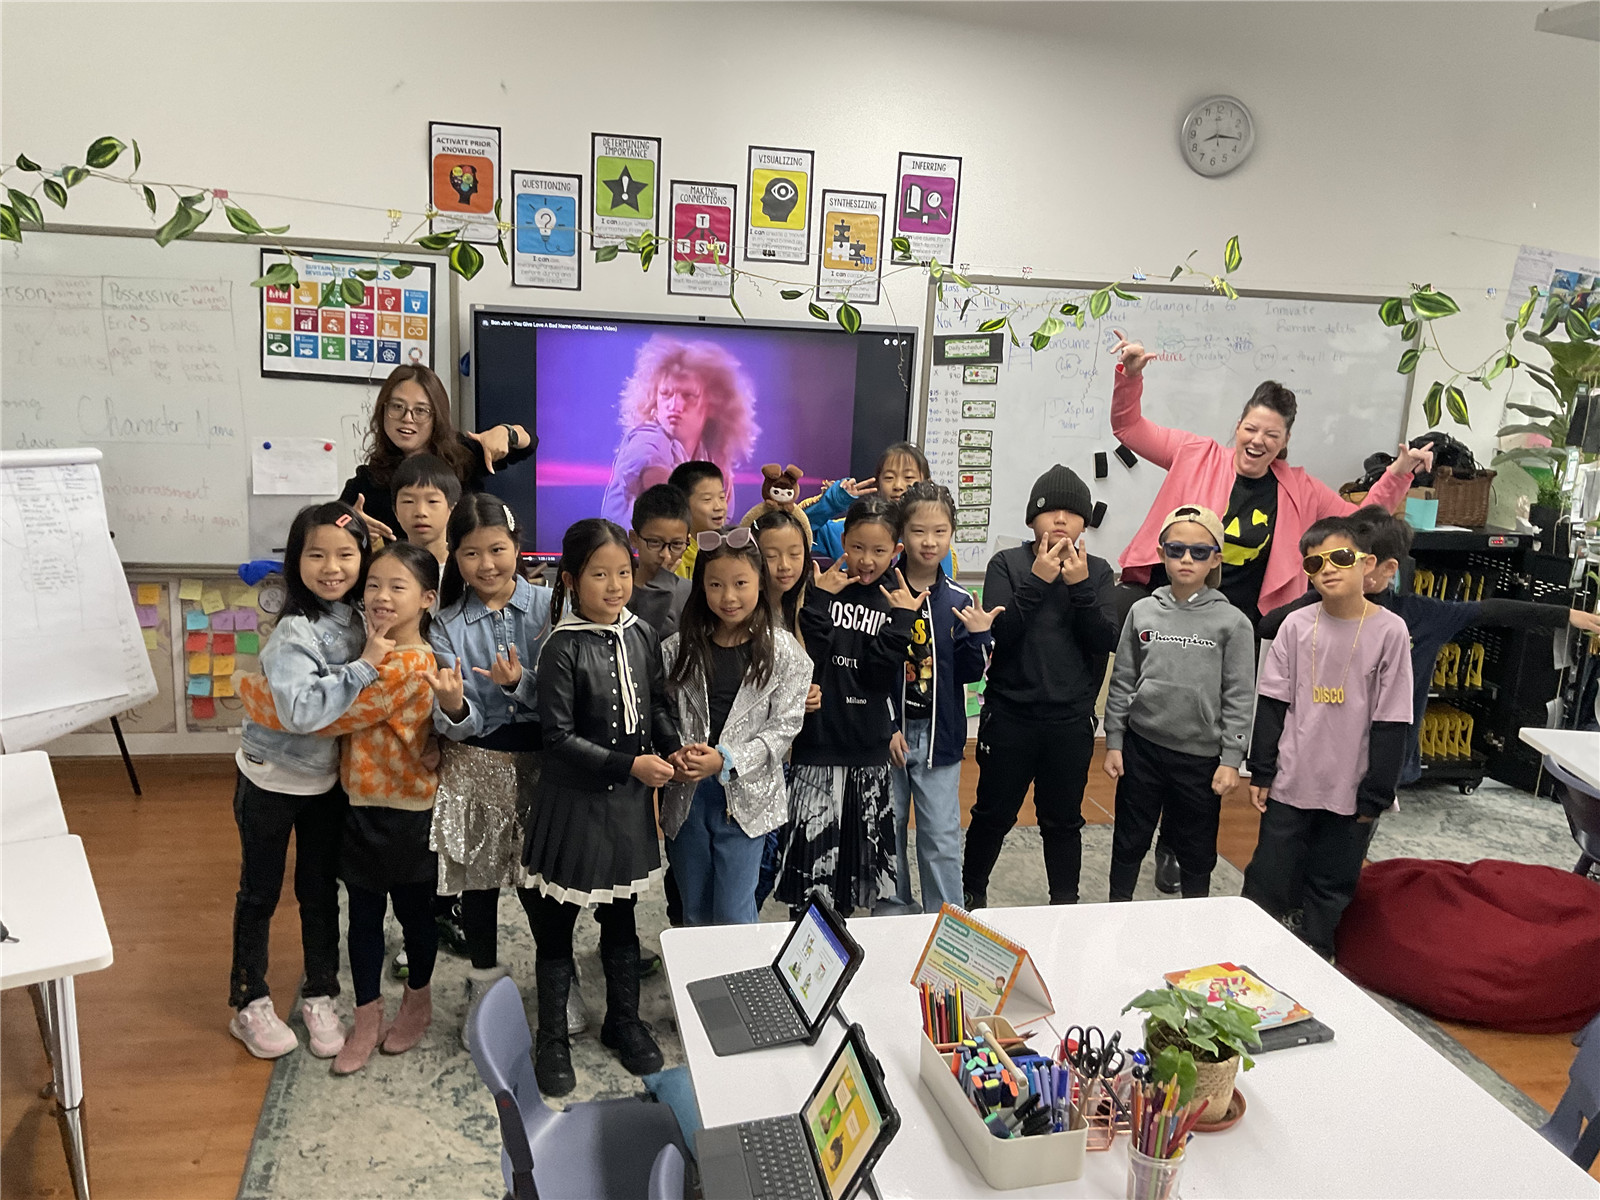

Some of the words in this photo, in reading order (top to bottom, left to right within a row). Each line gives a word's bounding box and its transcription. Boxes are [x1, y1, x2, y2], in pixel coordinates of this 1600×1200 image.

[436, 137, 469, 147] ACTIVATE
[470, 140, 492, 148] PRIOR
[602, 138, 650, 150] DETERMINING
[1191, 143, 1198, 153] 8
[441, 146, 486, 156] KNOWLEDGE
[604, 147, 648, 159] IMPORTANCE
[1231, 144, 1237, 153] 4
[758, 154, 803, 167] VISUALIZING
[1199, 152, 1206, 163] 7
[1209, 156, 1216, 167] 6
[1221, 153, 1228, 163] 5
[911, 160, 947, 172] INFERRING
[522, 179, 571, 192] QUESTIONING
[690, 186, 718, 196] MAKING
[680, 194, 728, 205] CONNECTIONS
[829, 197, 877, 209] SYNTHESIZING
[699, 215, 706, 226] T
[680, 241, 687, 251] T
[698, 242, 706, 253] S
[348, 267, 391, 281] GLS
[828, 600, 893, 636] OSCHIN
[1139, 629, 1216, 649] Champion
[846, 696, 867, 705] Milano
[1313, 686, 1345, 704] DISCO
